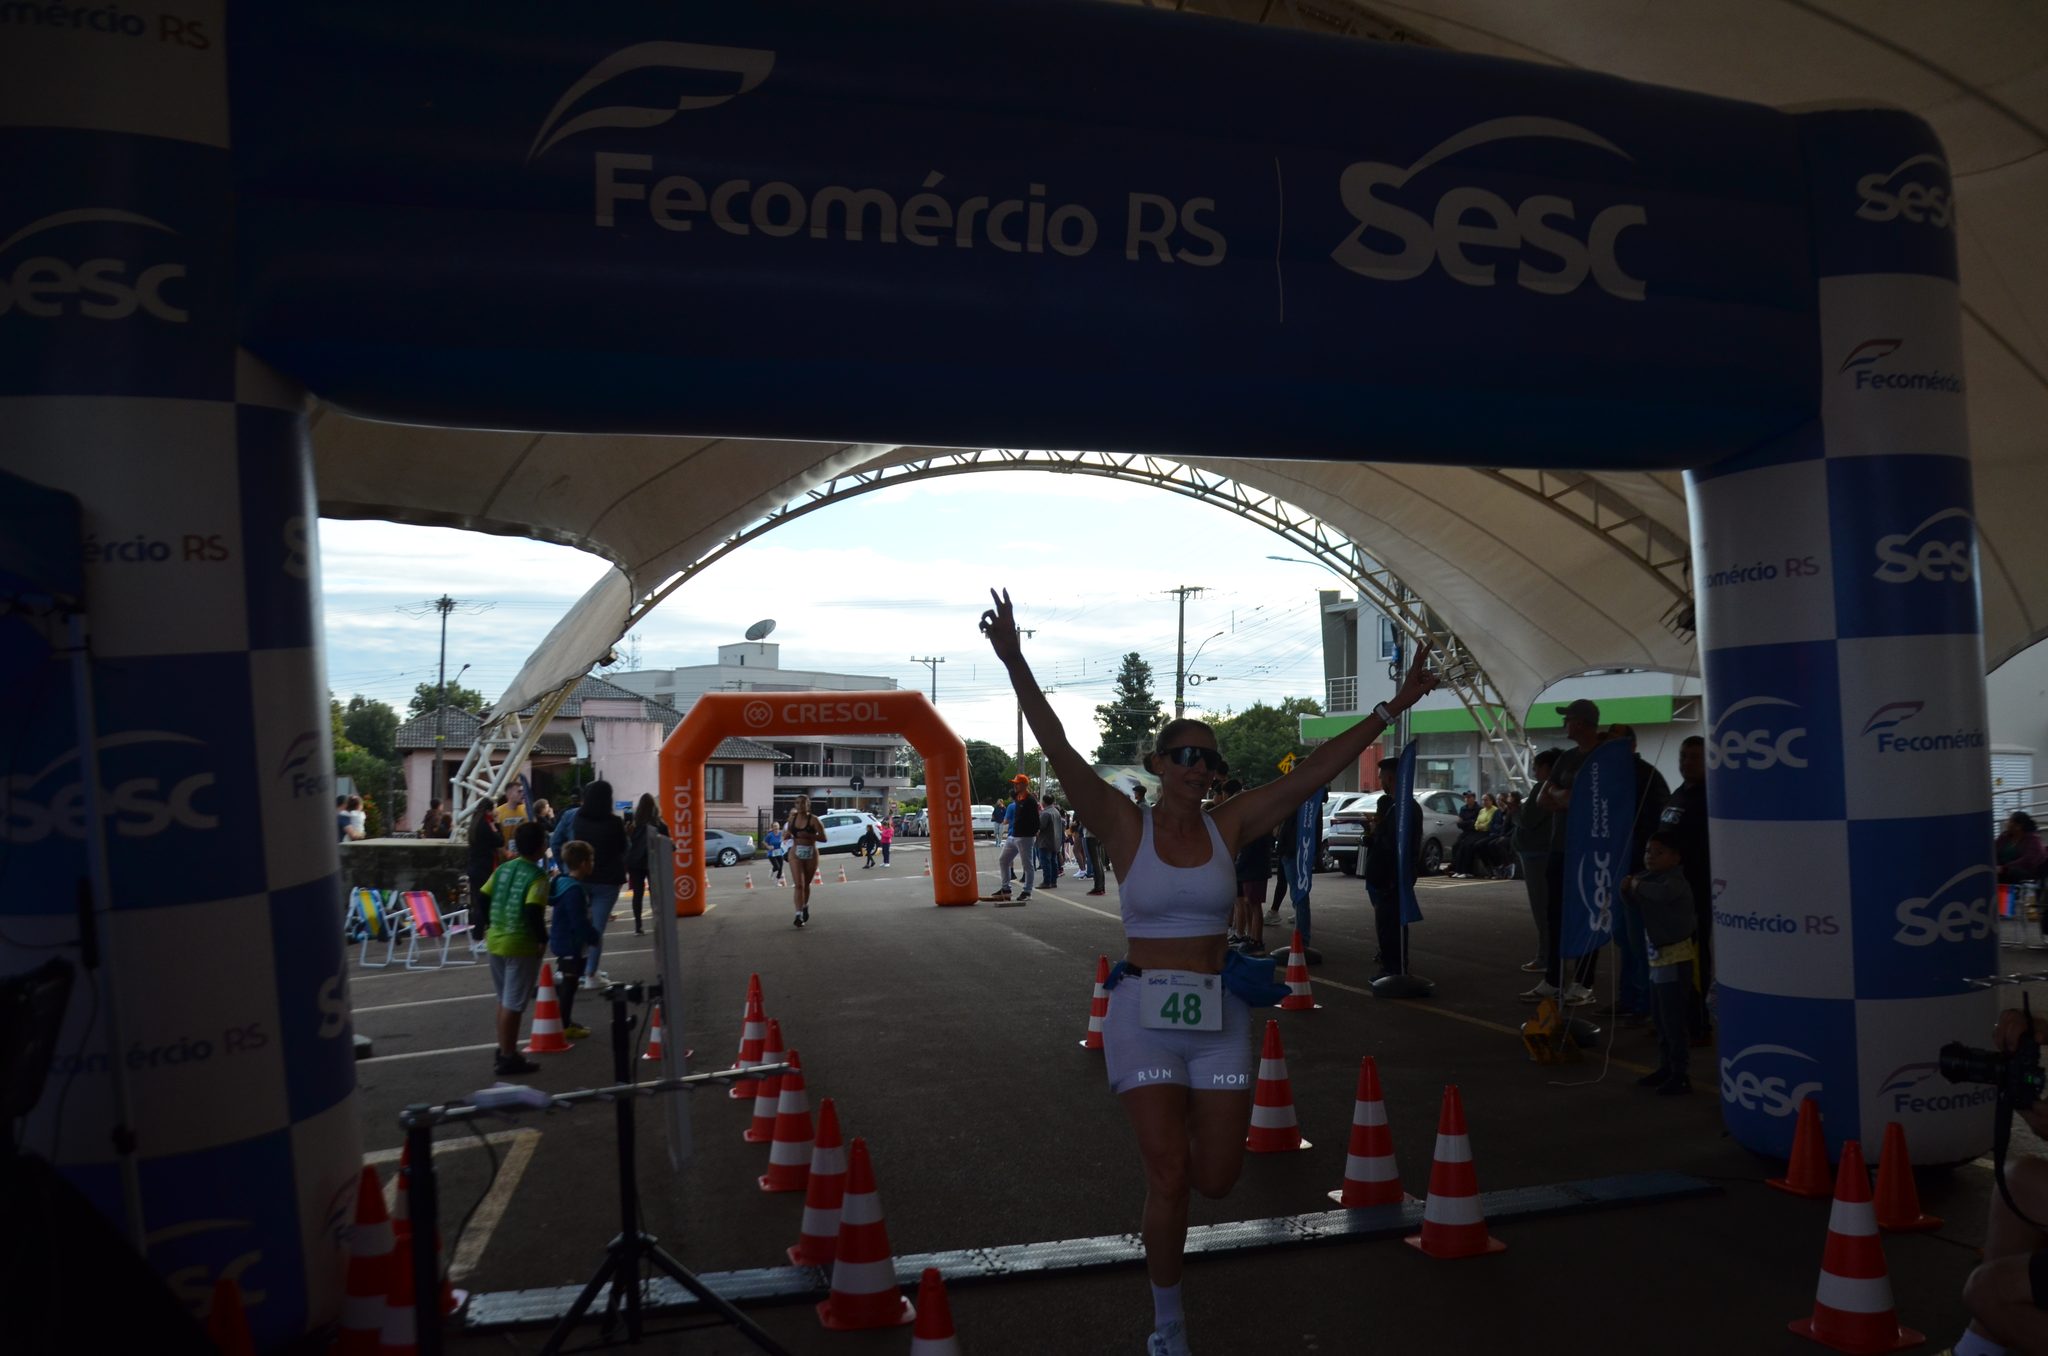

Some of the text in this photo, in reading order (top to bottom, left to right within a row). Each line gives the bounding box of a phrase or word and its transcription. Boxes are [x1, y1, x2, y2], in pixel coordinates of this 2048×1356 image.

[158, 13, 210, 50] RS
[593, 151, 1228, 267] Fecomércio RS
[1854, 172, 1953, 229] Ses
[1330, 160, 1647, 301] Sesc
[0, 255, 190, 323] esc
[183, 534, 229, 562] RS
[1784, 556, 1821, 579] RS
[782, 701, 888, 725] CRESOL
[944, 767, 967, 856] CRESOL
[1590, 761, 1600, 839] Fecomércio
[673, 777, 693, 868] CRESOL
[1804, 915, 1840, 935] RS
[1892, 896, 1998, 947] Ses
[1160, 991, 1202, 1025] 48
[224, 1022, 268, 1054] RS
[1137, 1068, 1172, 1082] RUN
